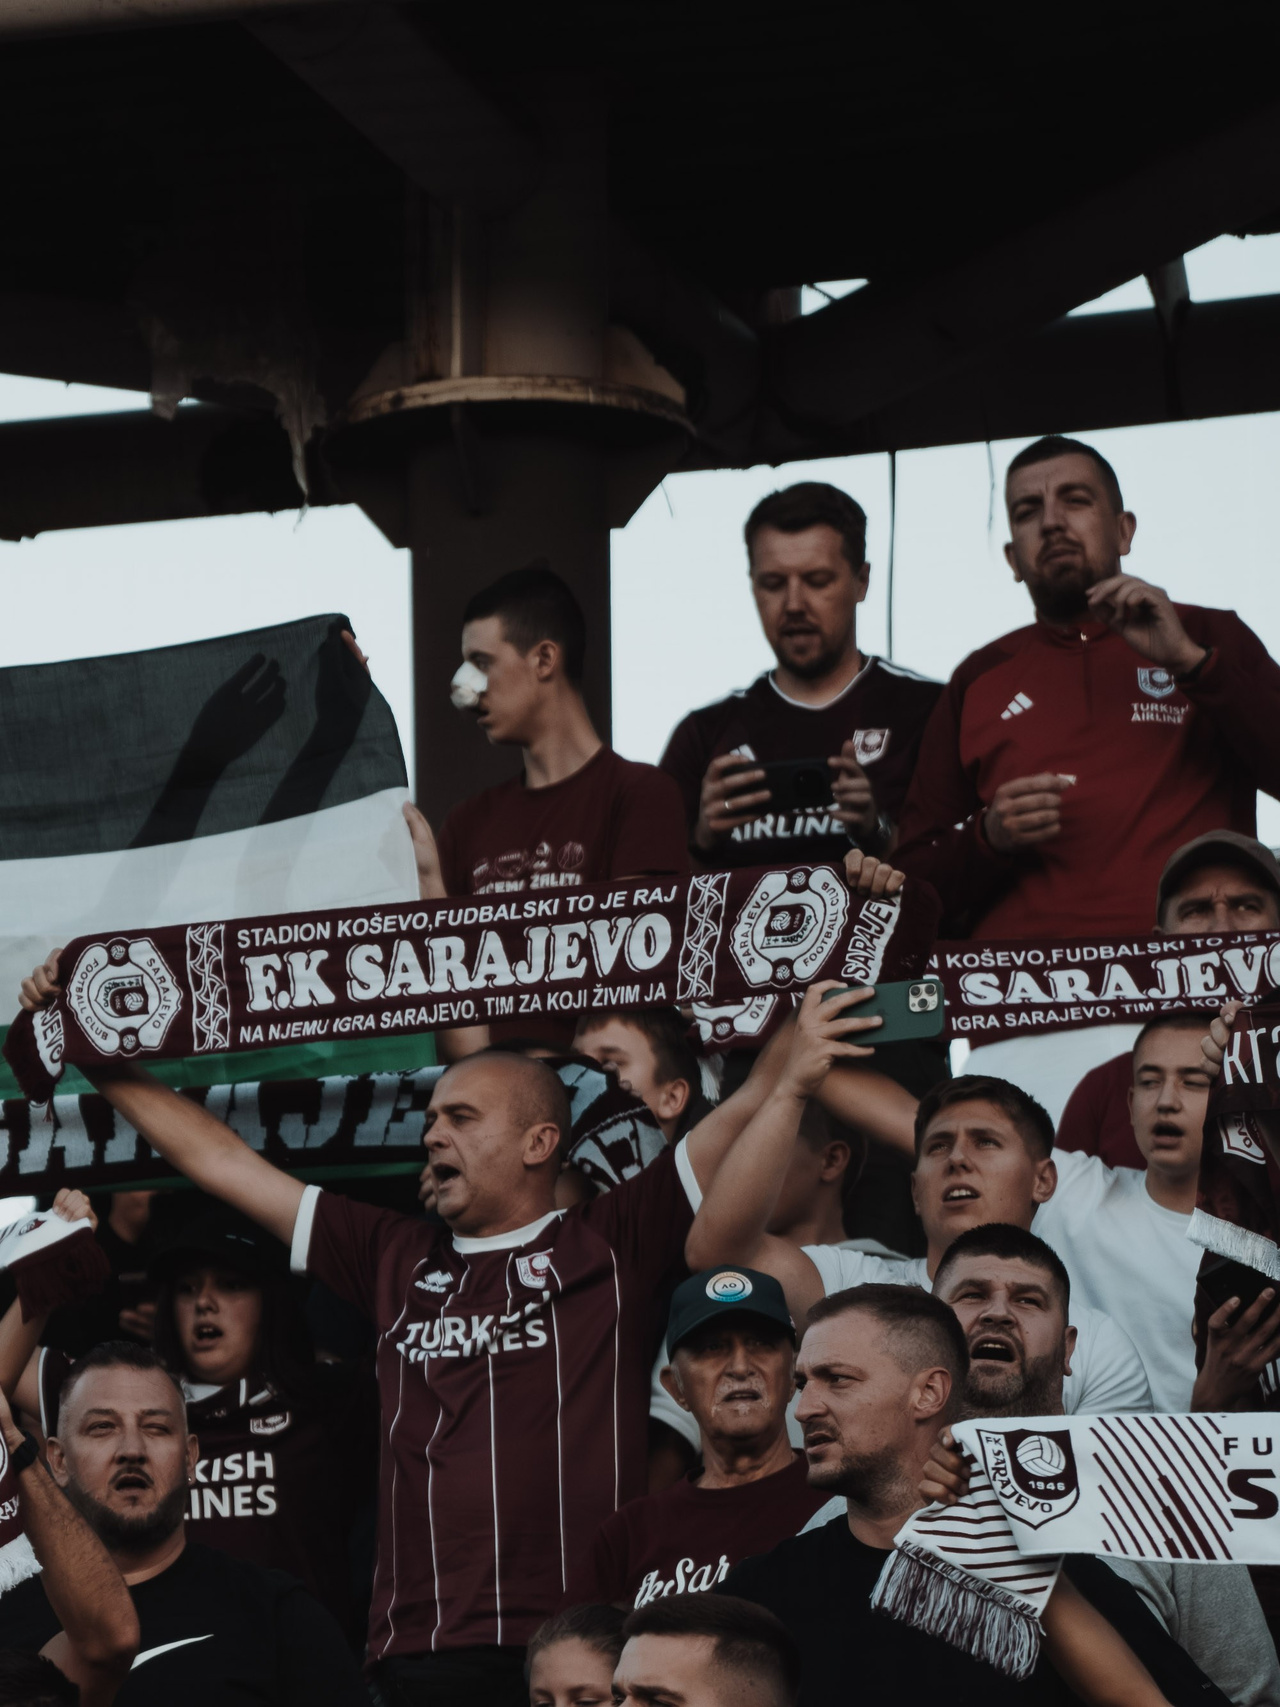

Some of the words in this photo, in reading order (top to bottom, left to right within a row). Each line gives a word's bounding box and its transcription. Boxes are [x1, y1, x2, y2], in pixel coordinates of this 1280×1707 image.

[1130, 712, 1184, 725] AIRLINE
[730, 811, 847, 843] AIRLINE
[236, 921, 331, 949] STADION
[566, 894, 595, 913] TO
[599, 890, 628, 910] JE
[632, 885, 678, 906] RAJ
[841, 897, 899, 981] SARAJEV
[1191, 937, 1223, 949] TO
[1229, 933, 1258, 944] JE
[345, 911, 673, 1004] SARAJEVO
[146, 957, 172, 1030] SARAJEVO
[84, 1015, 110, 1042] CLUB
[239, 1024, 264, 1044] NA
[268, 1018, 329, 1041] NJEMU
[332, 1014, 376, 1034] IGRA
[380, 999, 480, 1029] SARAJEVO,
[483, 996, 514, 1017] TIM
[518, 993, 543, 1014] ZA
[546, 989, 588, 1011] KOJI
[591, 983, 641, 1008] ŽIVIM
[643, 982, 667, 1002] JA
[951, 1013, 1001, 1032] IGRA
[1004, 1005, 1117, 1028] SARAJEVO,
[1120, 1001, 1155, 1015] TIM
[1160, 999, 1187, 1011] ZA
[40, 1006, 64, 1064] JEVO
[985, 1436, 1003, 1447] FK
[990, 1448, 1054, 1514] SARAJEVO
[1028, 1479, 1065, 1491] 1946
[184, 1484, 278, 1520] INES
